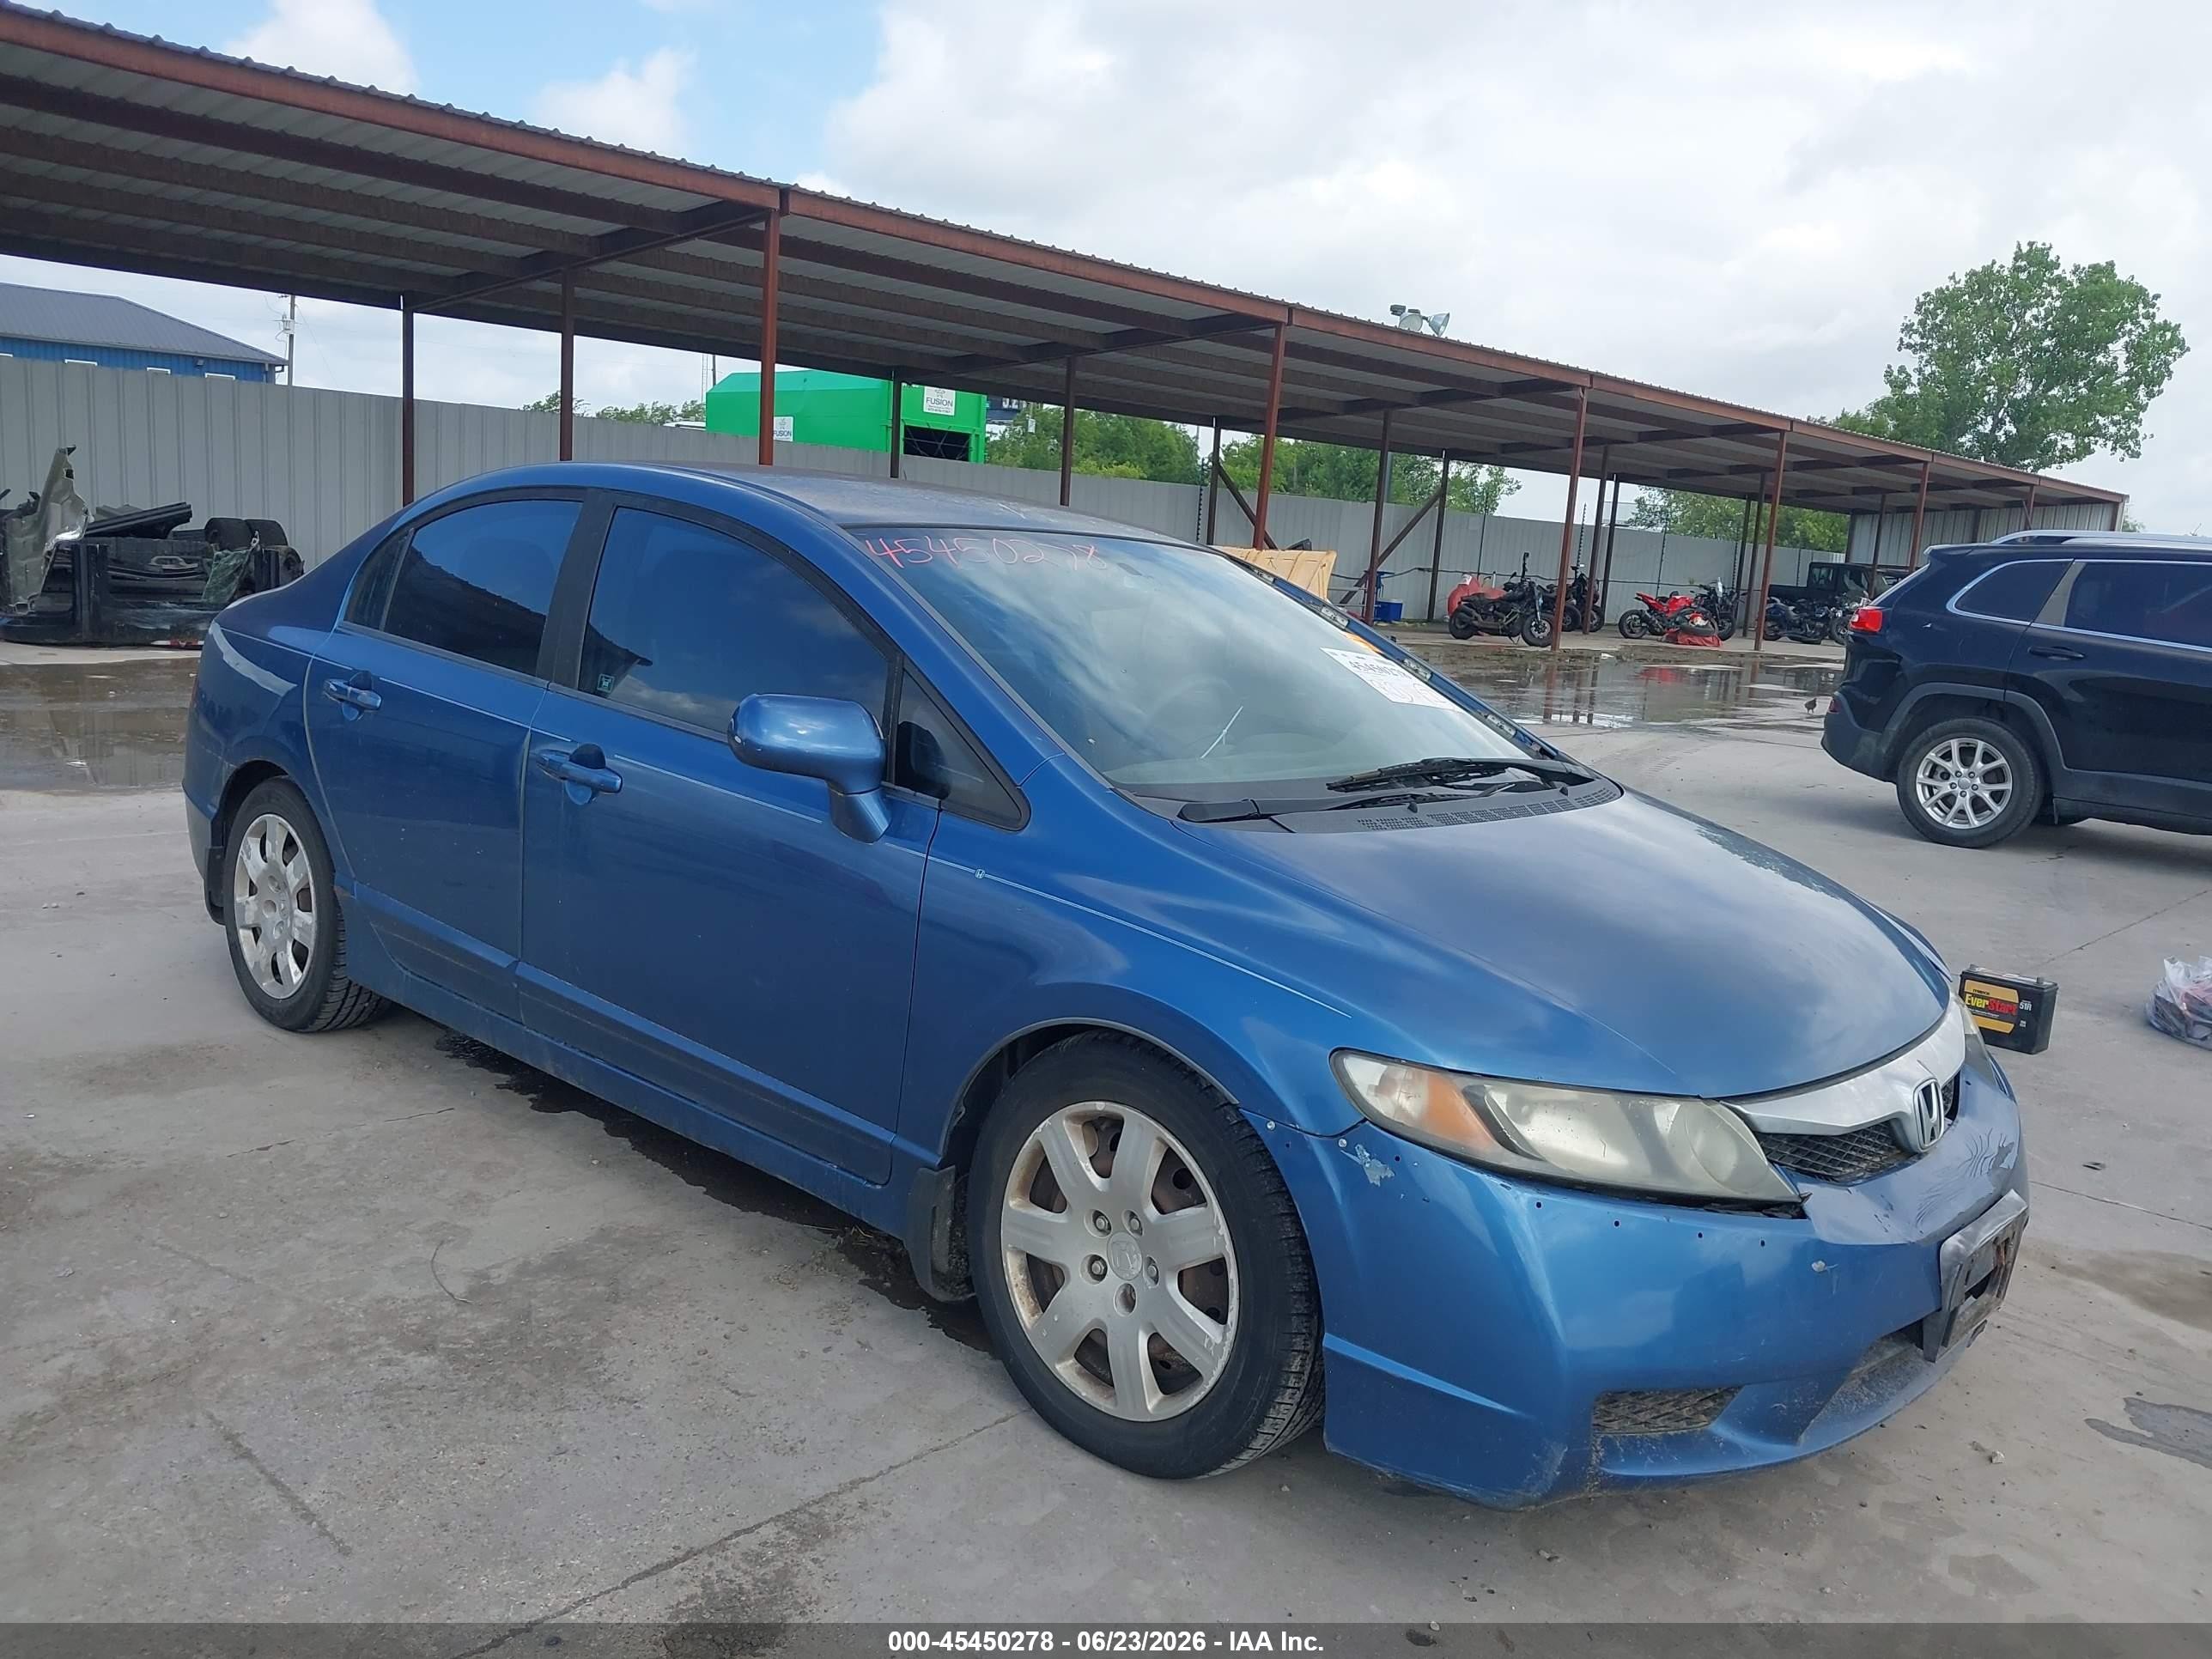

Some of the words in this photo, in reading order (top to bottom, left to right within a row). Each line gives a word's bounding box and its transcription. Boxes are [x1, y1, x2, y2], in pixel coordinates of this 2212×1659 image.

[926, 397, 953, 407] FUSION
[865, 535, 1107, 570] 45450278
[1965, 994, 2017, 1016] EverStart
